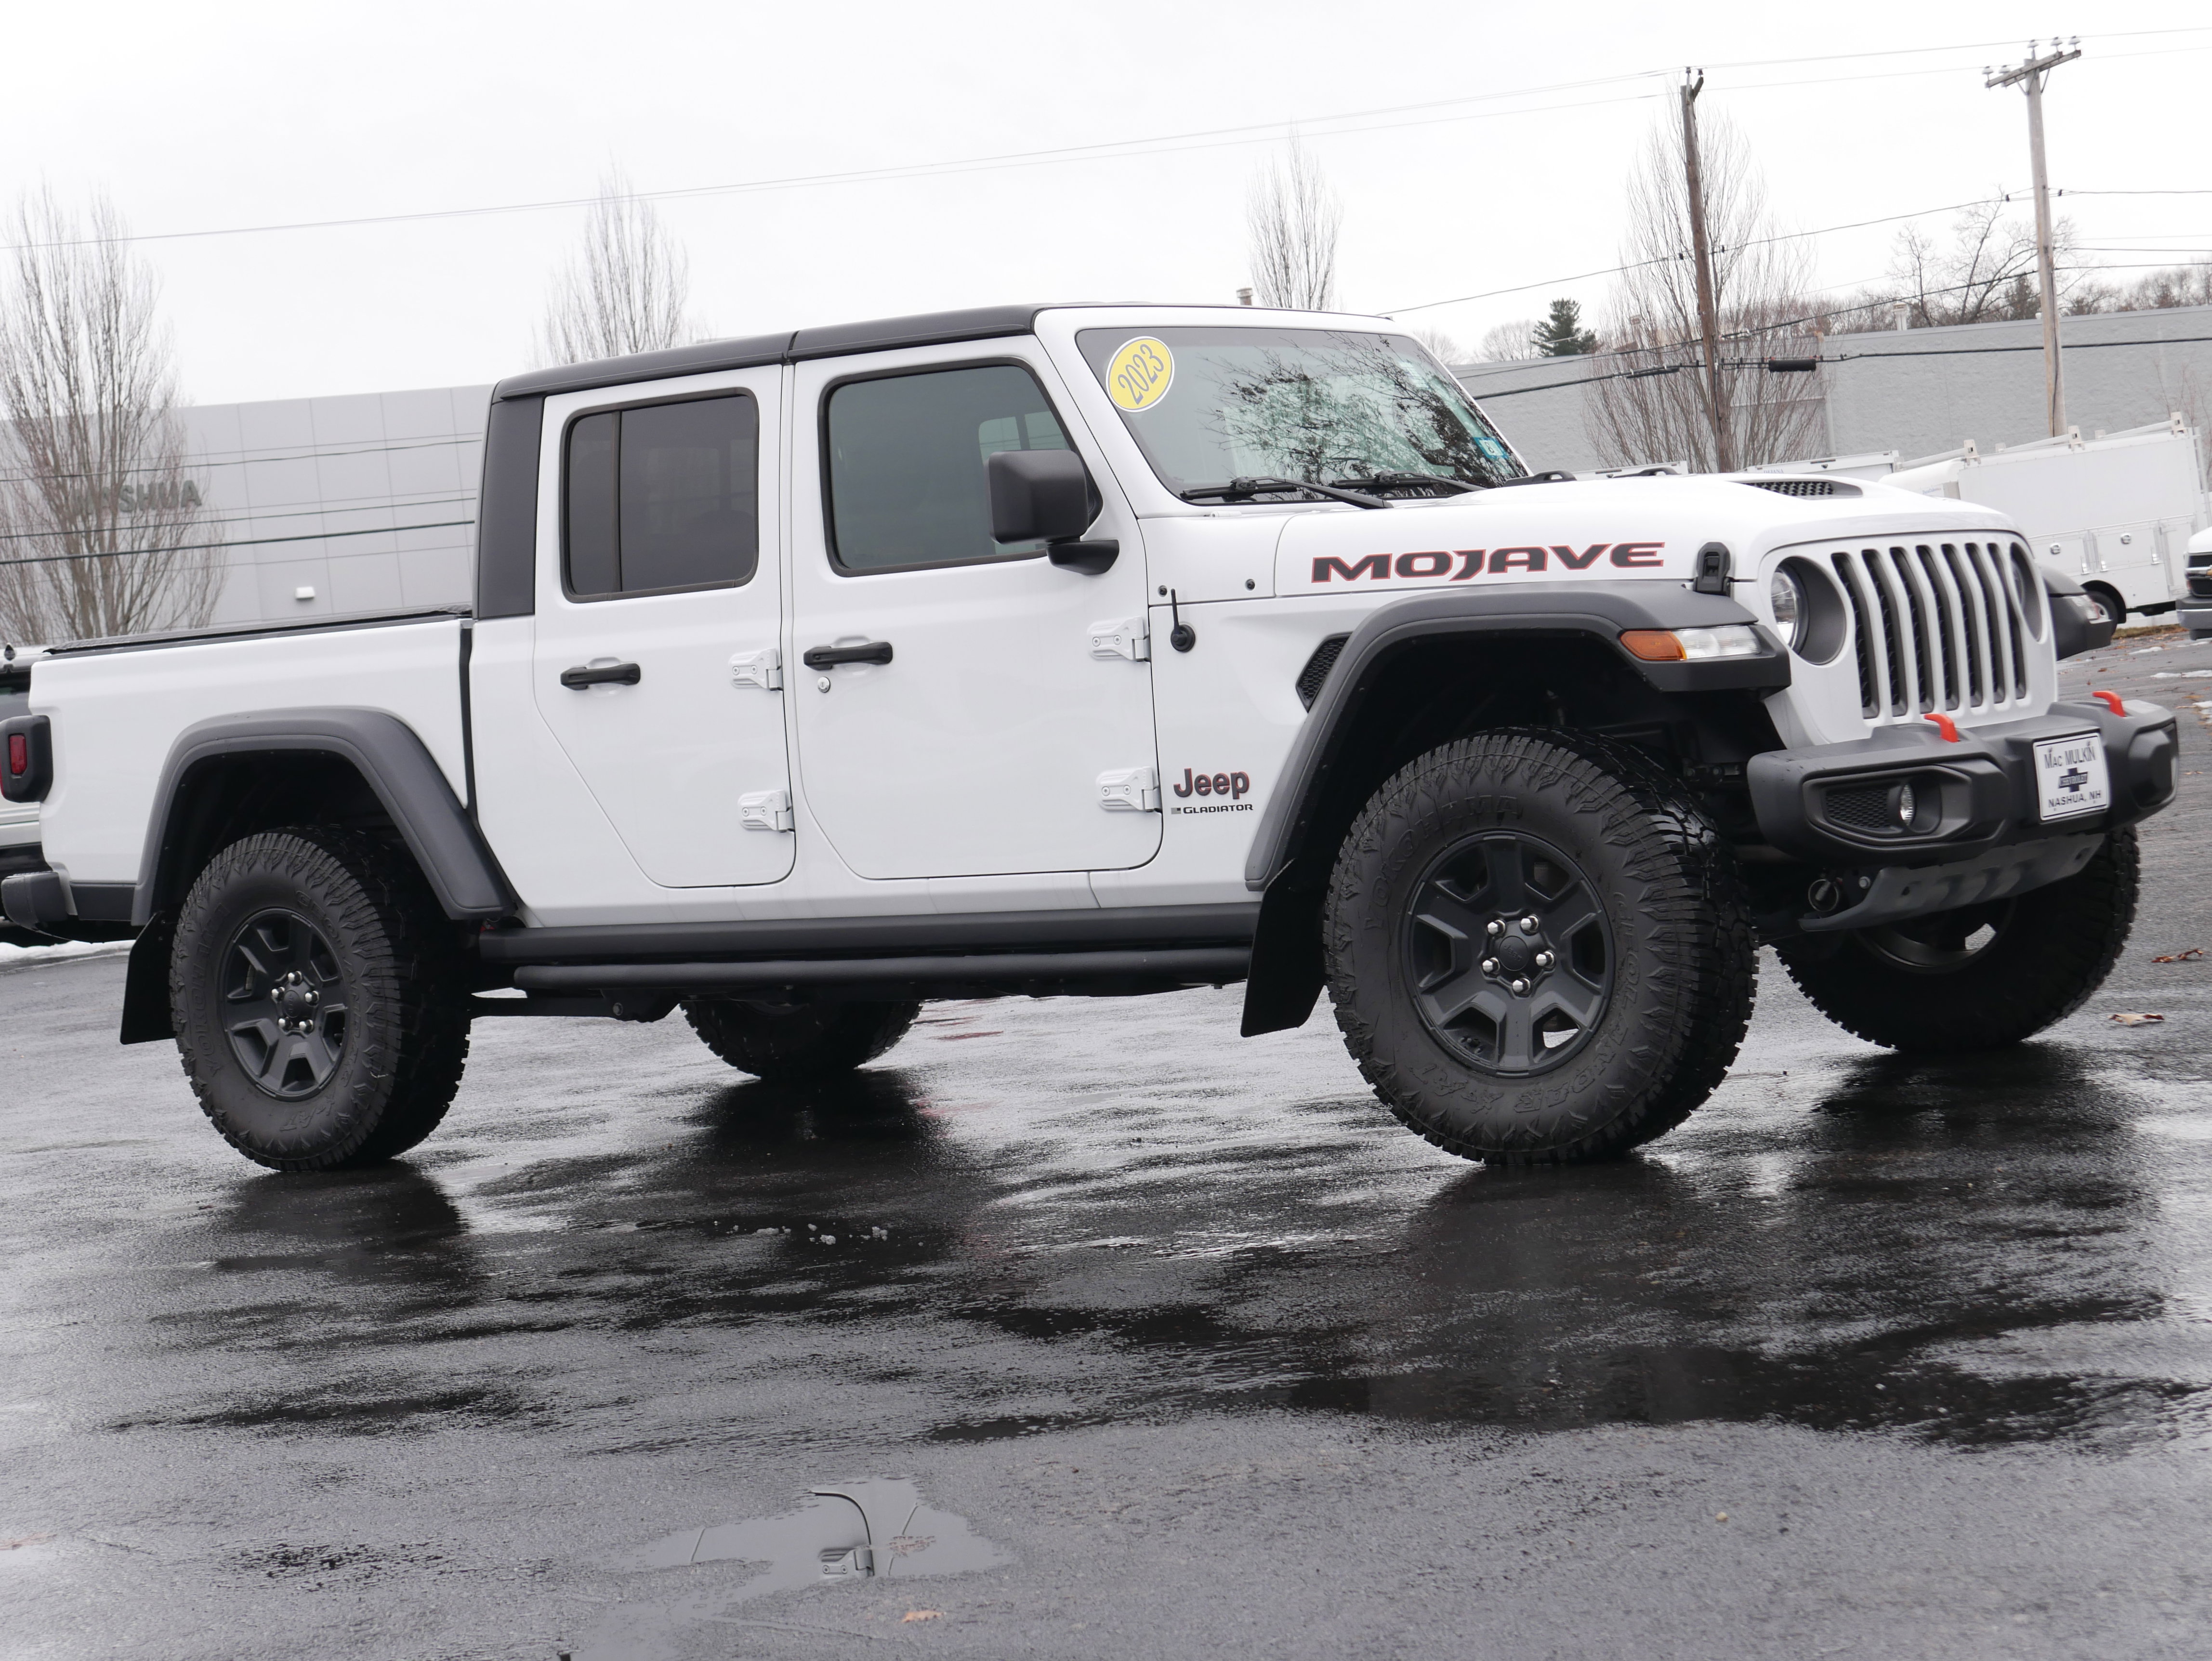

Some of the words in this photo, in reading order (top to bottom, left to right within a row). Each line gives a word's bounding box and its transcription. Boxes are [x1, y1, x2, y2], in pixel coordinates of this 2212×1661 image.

[1118, 344, 1164, 405] 2023
[1311, 542, 1665, 583] MOJAVE
[2065, 746, 2096, 765] MULKIN
[1173, 768, 1250, 800] Jeep
[2089, 790, 2102, 800] NH
[1183, 804, 1254, 814] GLADIATOR
[1364, 795, 1522, 931] YOKOHAMA
[1503, 944, 1523, 963] Jeep
[192, 902, 231, 1078] YOKOHAMA
